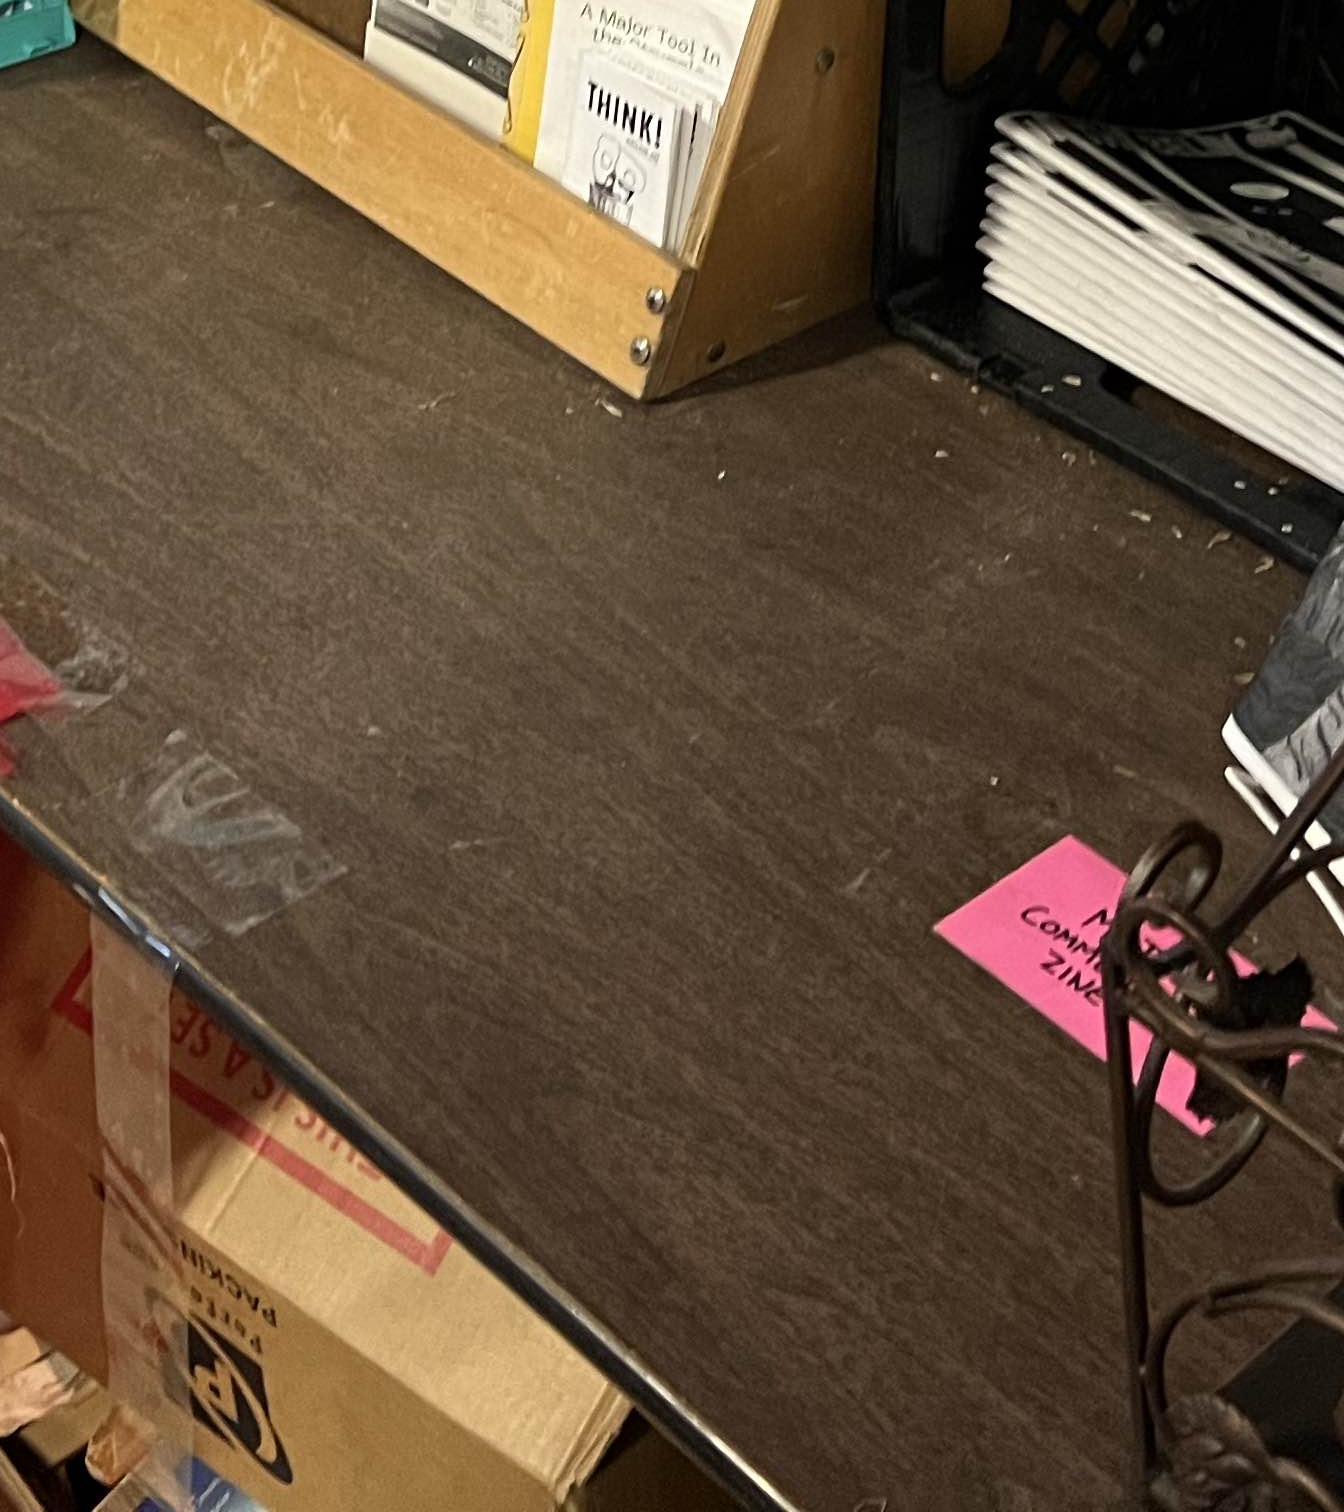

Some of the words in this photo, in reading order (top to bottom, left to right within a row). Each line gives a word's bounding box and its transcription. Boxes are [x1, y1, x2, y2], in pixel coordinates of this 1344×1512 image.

[580, 1, 593, 21] A
[599, 7, 650, 37] Major
[656, 26, 695, 58] Tool
[587, 79, 663, 150] THINK!
